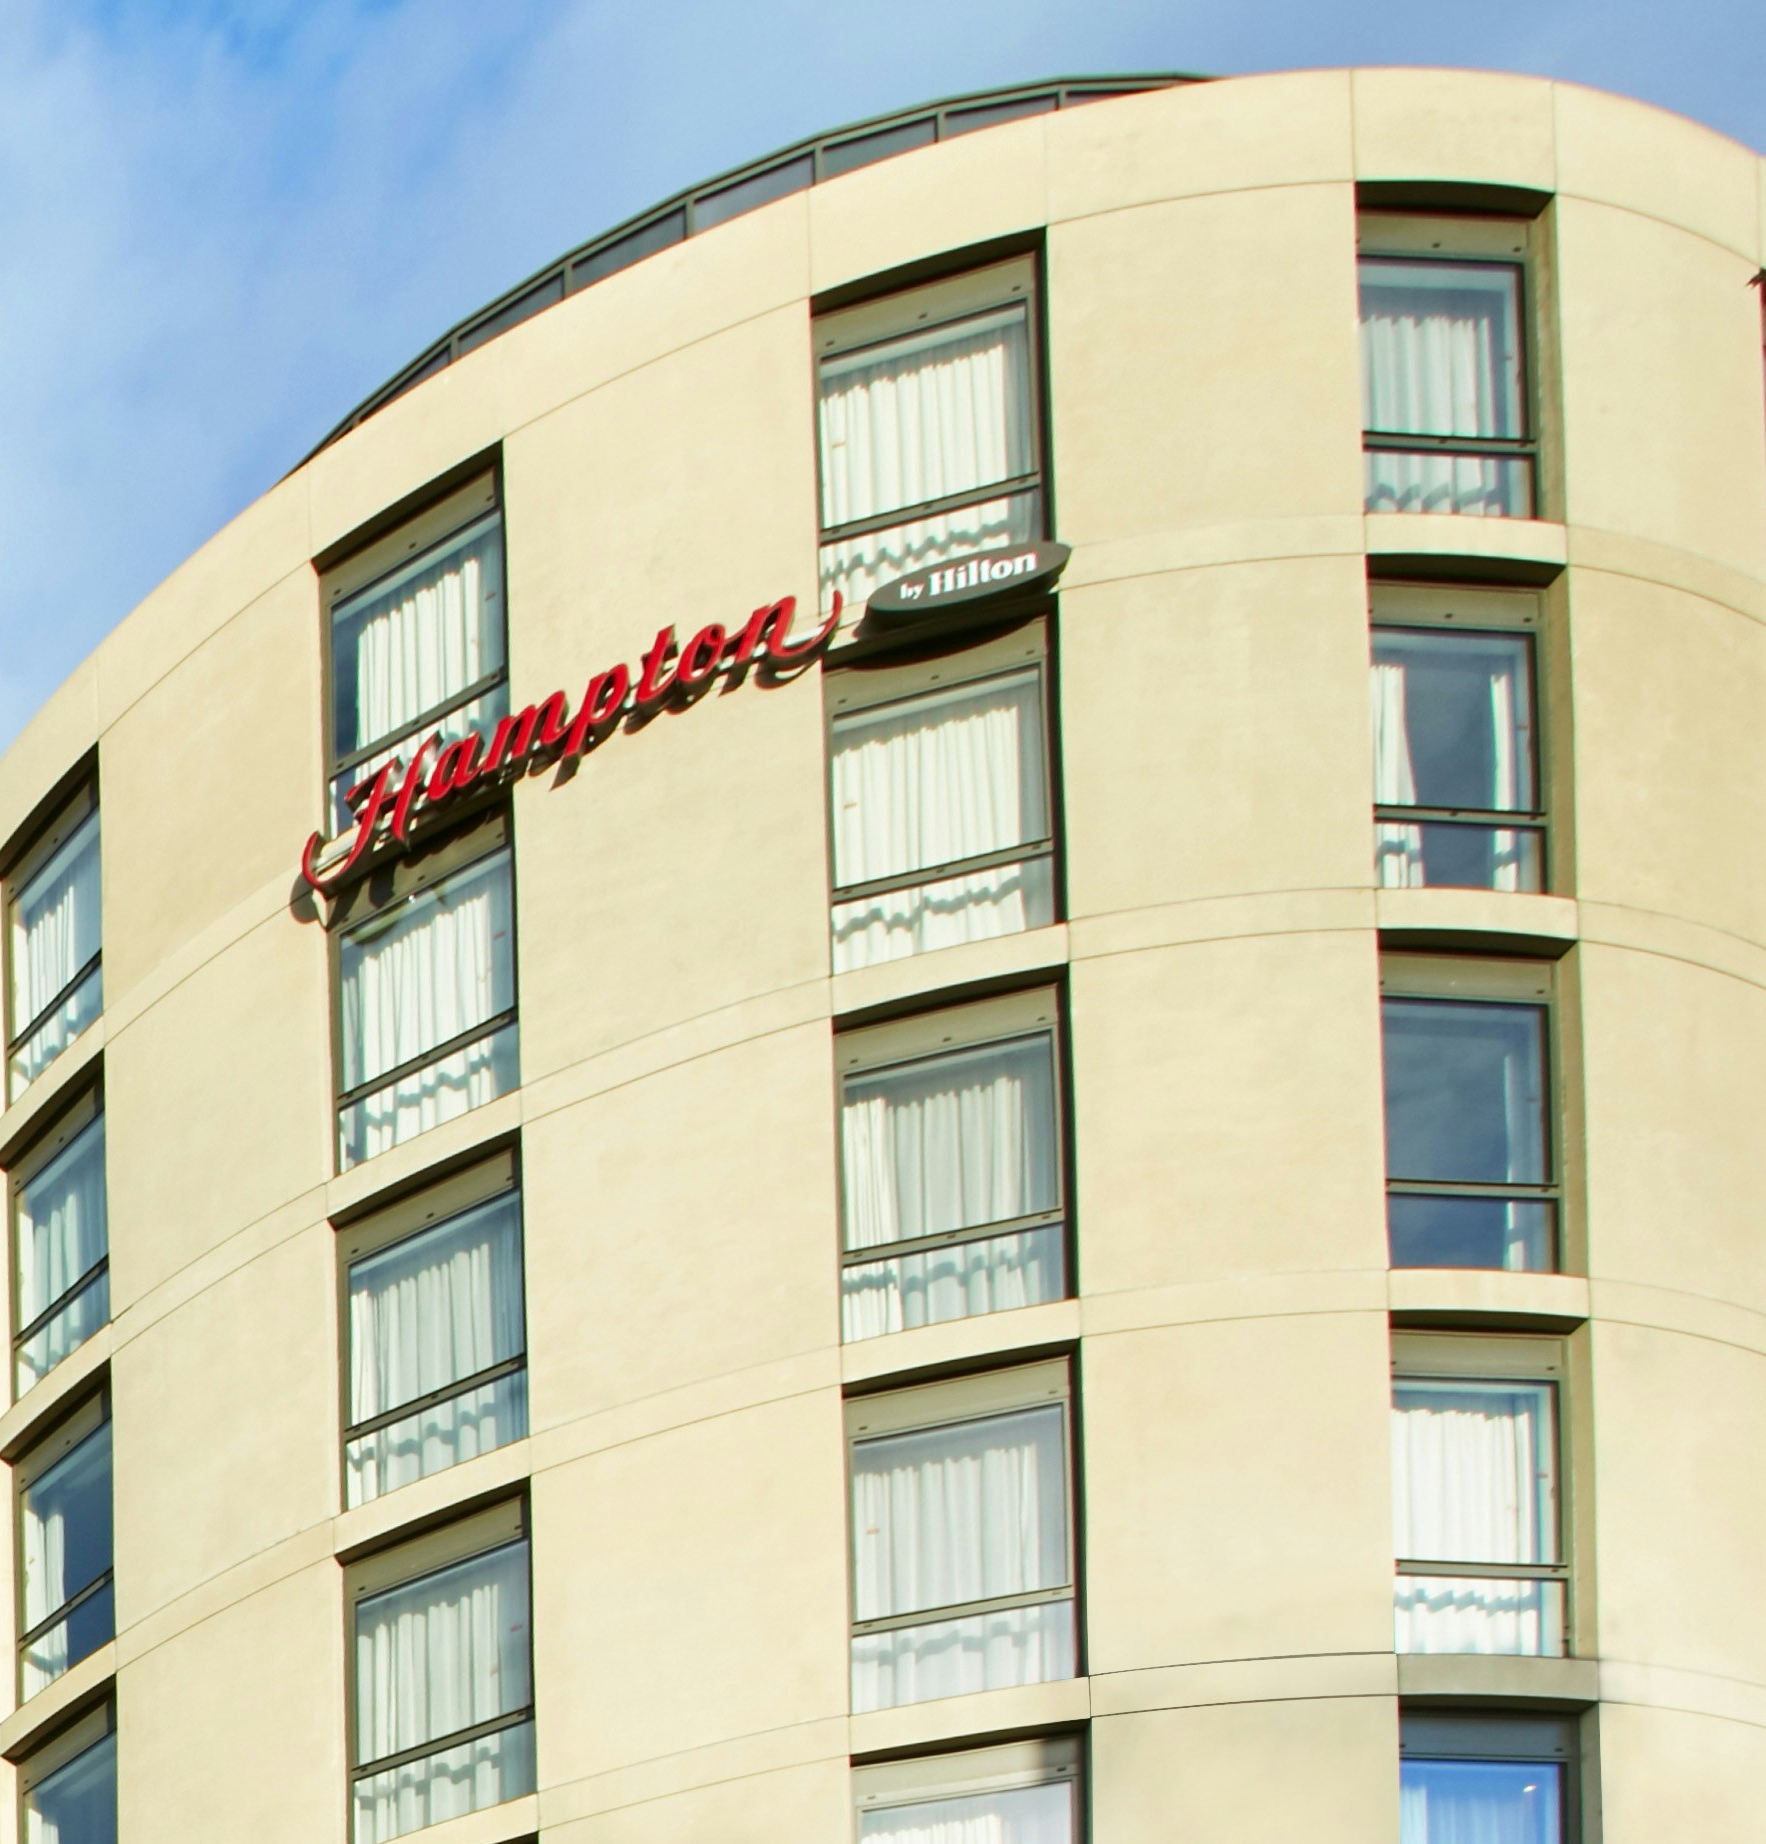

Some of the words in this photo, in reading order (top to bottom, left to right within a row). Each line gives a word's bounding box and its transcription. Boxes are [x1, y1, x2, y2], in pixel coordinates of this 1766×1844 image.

[303, 590, 842, 889] Hampton
[899, 583, 924, 600] by
[930, 551, 1037, 596] Hilton
